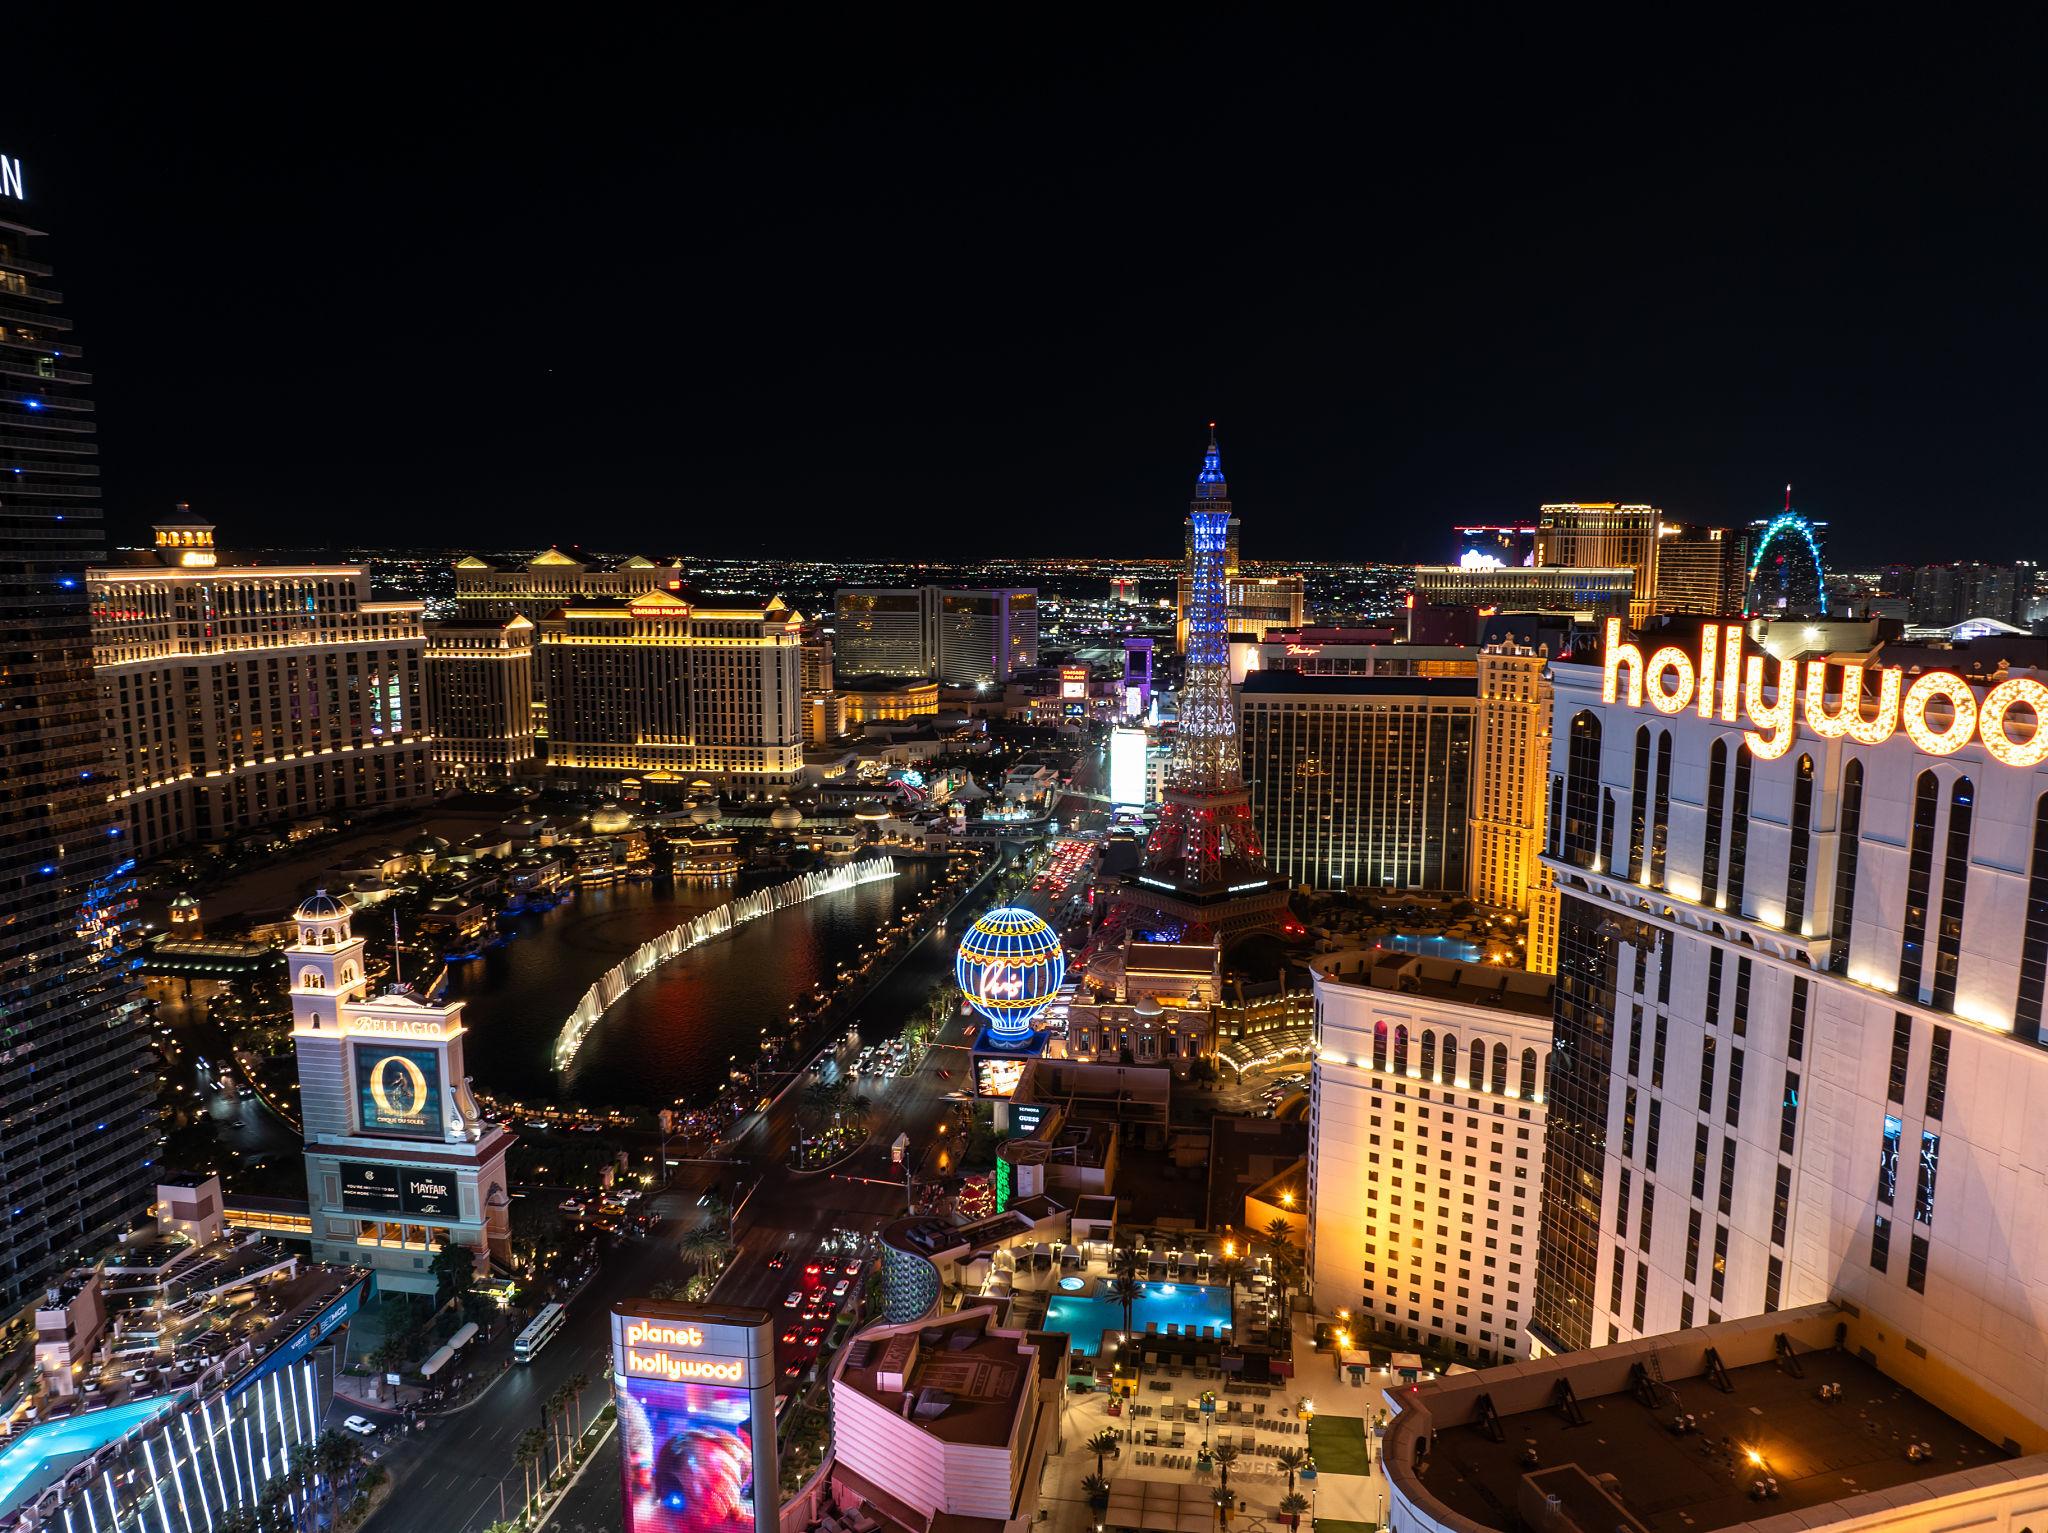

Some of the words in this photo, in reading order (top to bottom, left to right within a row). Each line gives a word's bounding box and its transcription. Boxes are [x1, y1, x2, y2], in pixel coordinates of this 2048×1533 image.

[0, 154, 24, 200] N
[661, 608, 687, 616] PALACE
[1601, 616, 2048, 768] hollywoo
[355, 1016, 440, 1034] BELLAGIO
[370, 1055, 428, 1117] O
[410, 1182, 448, 1196] MAYFAIR
[320, 1303, 347, 1330] BETMGM
[627, 1320, 704, 1347] planet
[628, 1350, 742, 1381] hollywood
